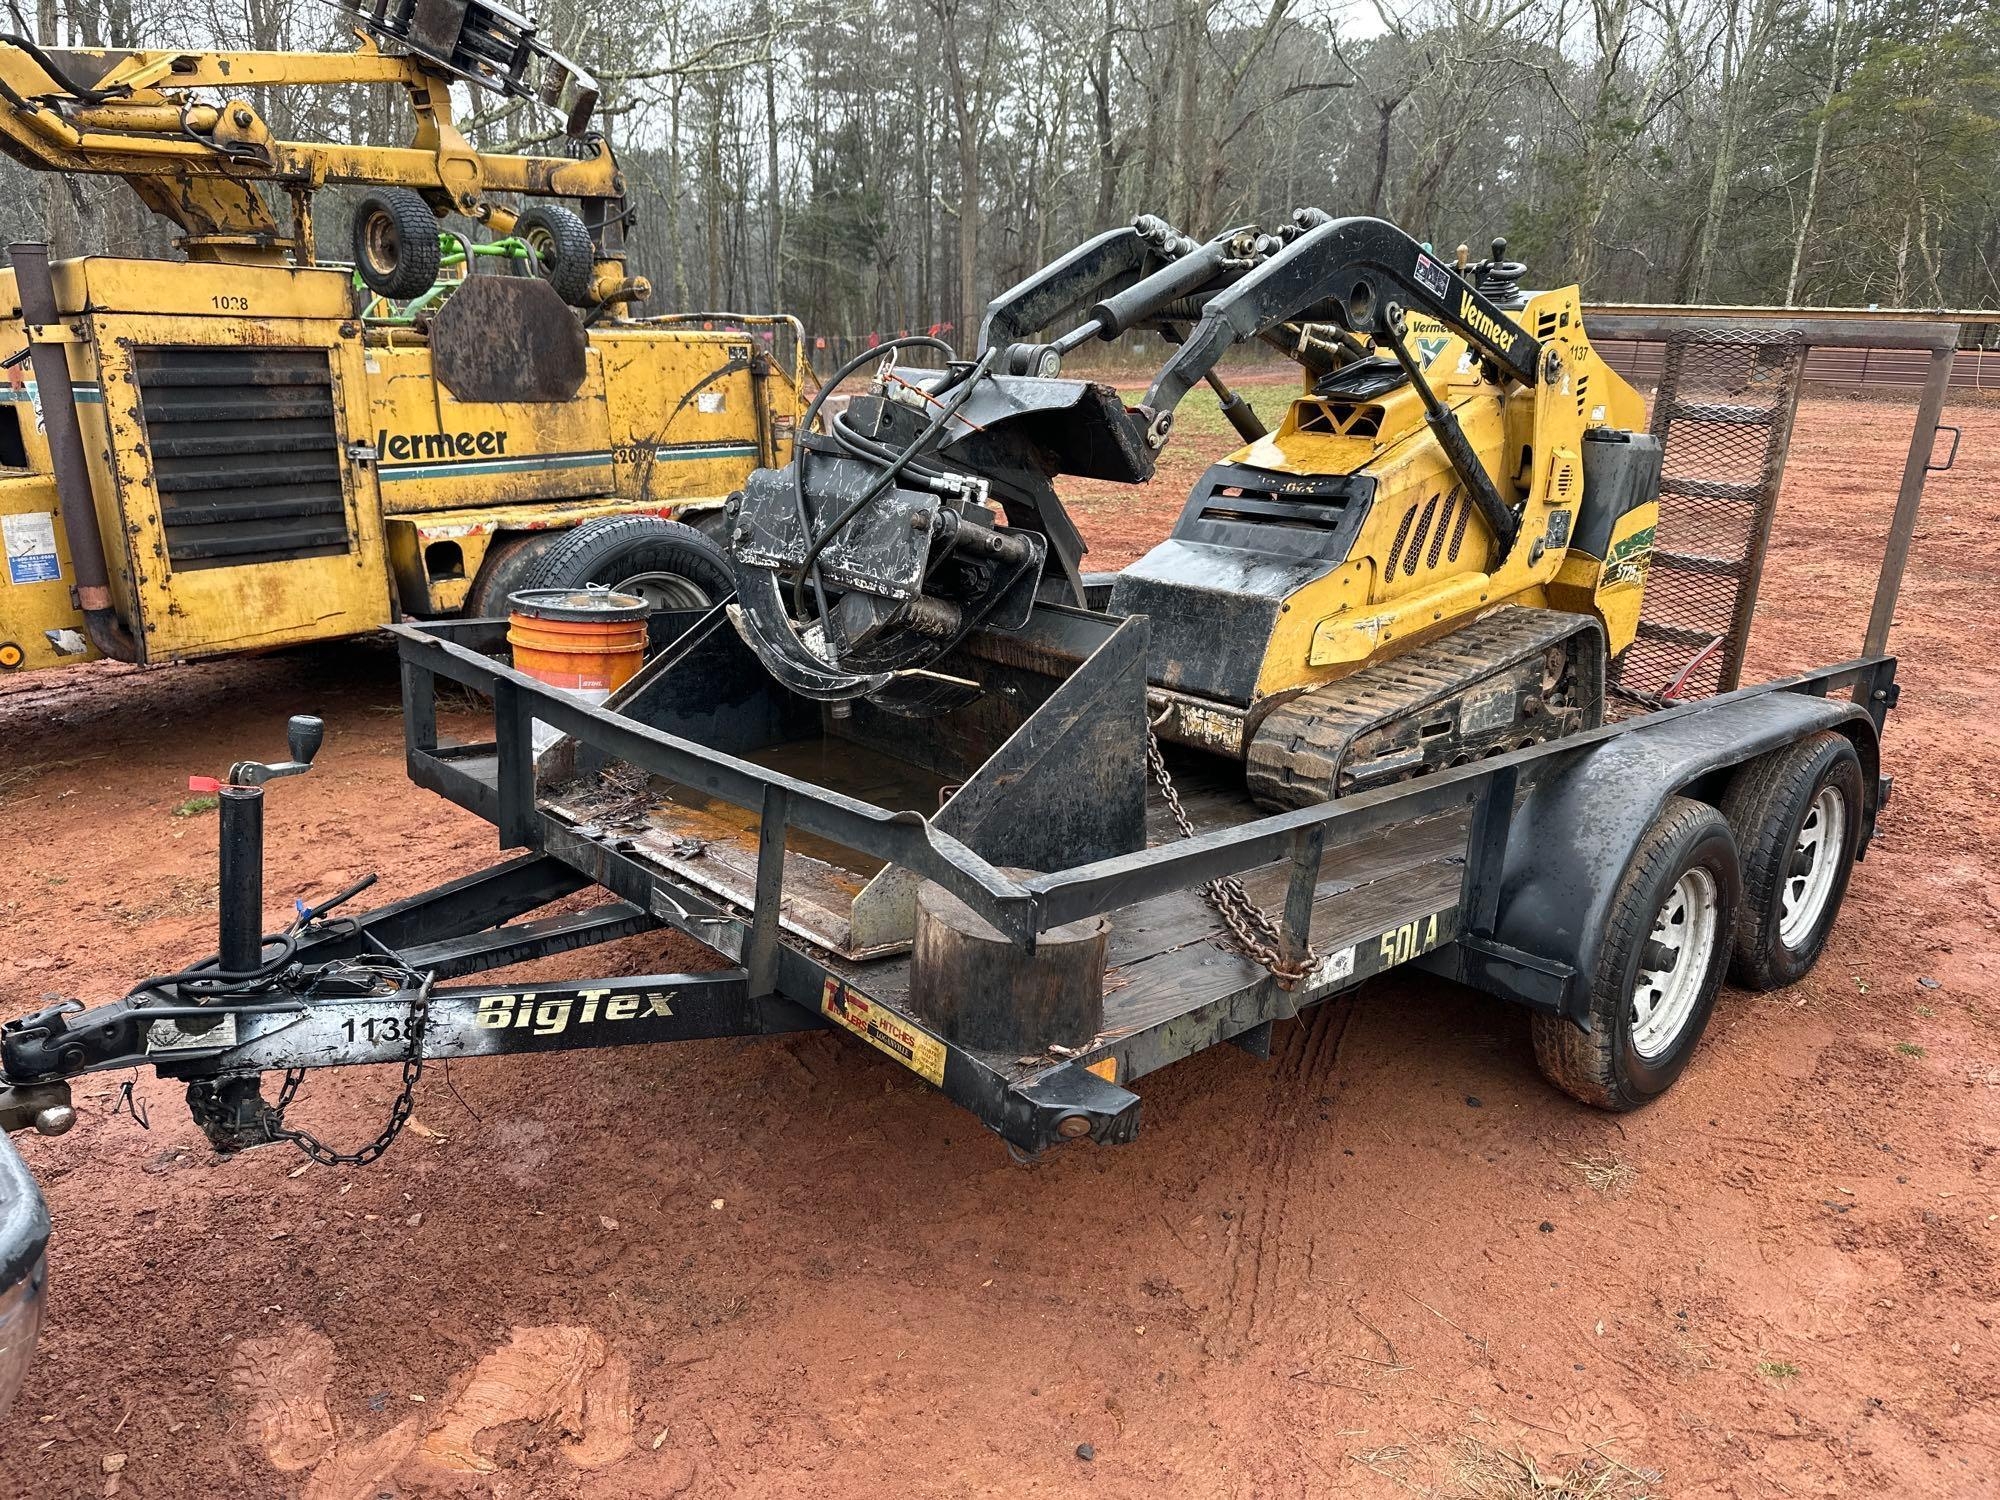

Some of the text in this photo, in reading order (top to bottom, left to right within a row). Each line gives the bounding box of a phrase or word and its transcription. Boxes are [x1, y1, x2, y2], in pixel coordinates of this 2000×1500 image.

[1460, 289, 1518, 353] Vermeer
[876, 1030, 909, 1057] LOGANVILLE
[879, 1017, 915, 1047] HITCHES
